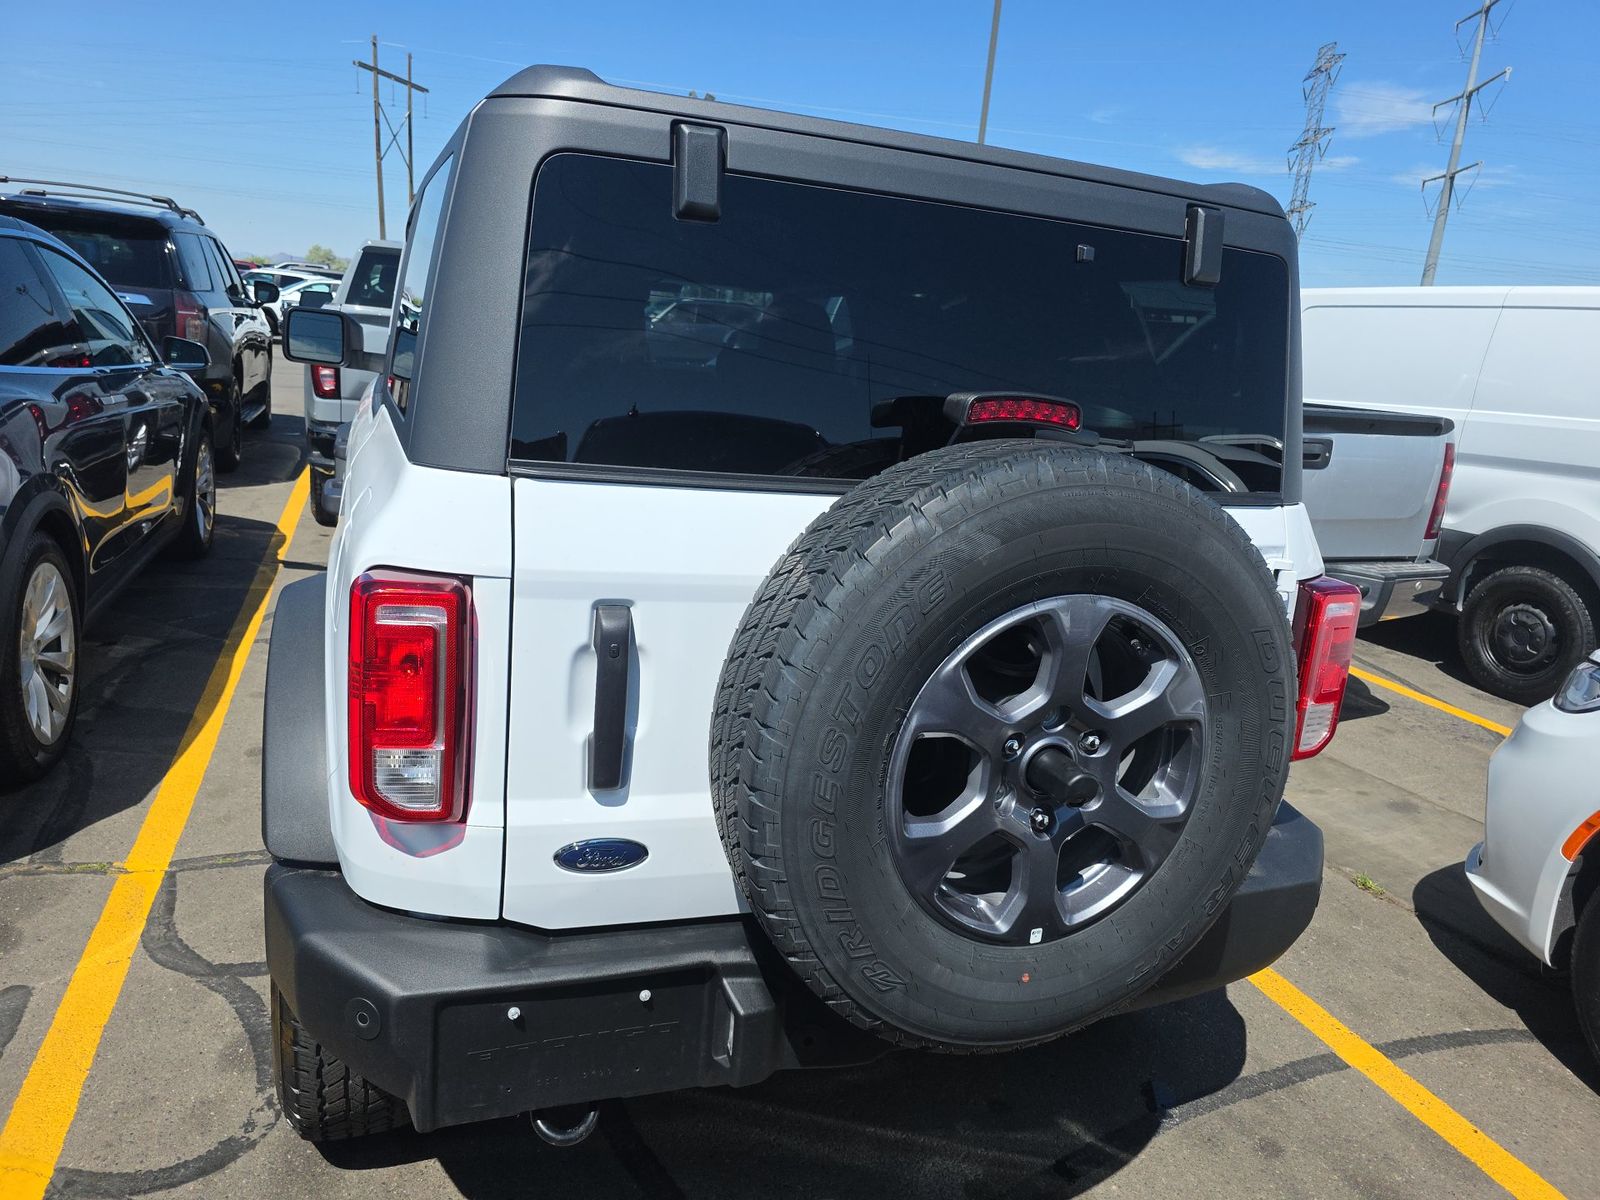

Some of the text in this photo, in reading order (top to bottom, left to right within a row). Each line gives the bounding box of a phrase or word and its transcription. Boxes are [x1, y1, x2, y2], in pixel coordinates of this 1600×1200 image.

[576, 847, 628, 868] Ford
[808, 568, 948, 993] BRIDGESTONE
[1202, 629, 1286, 916] DUELER
